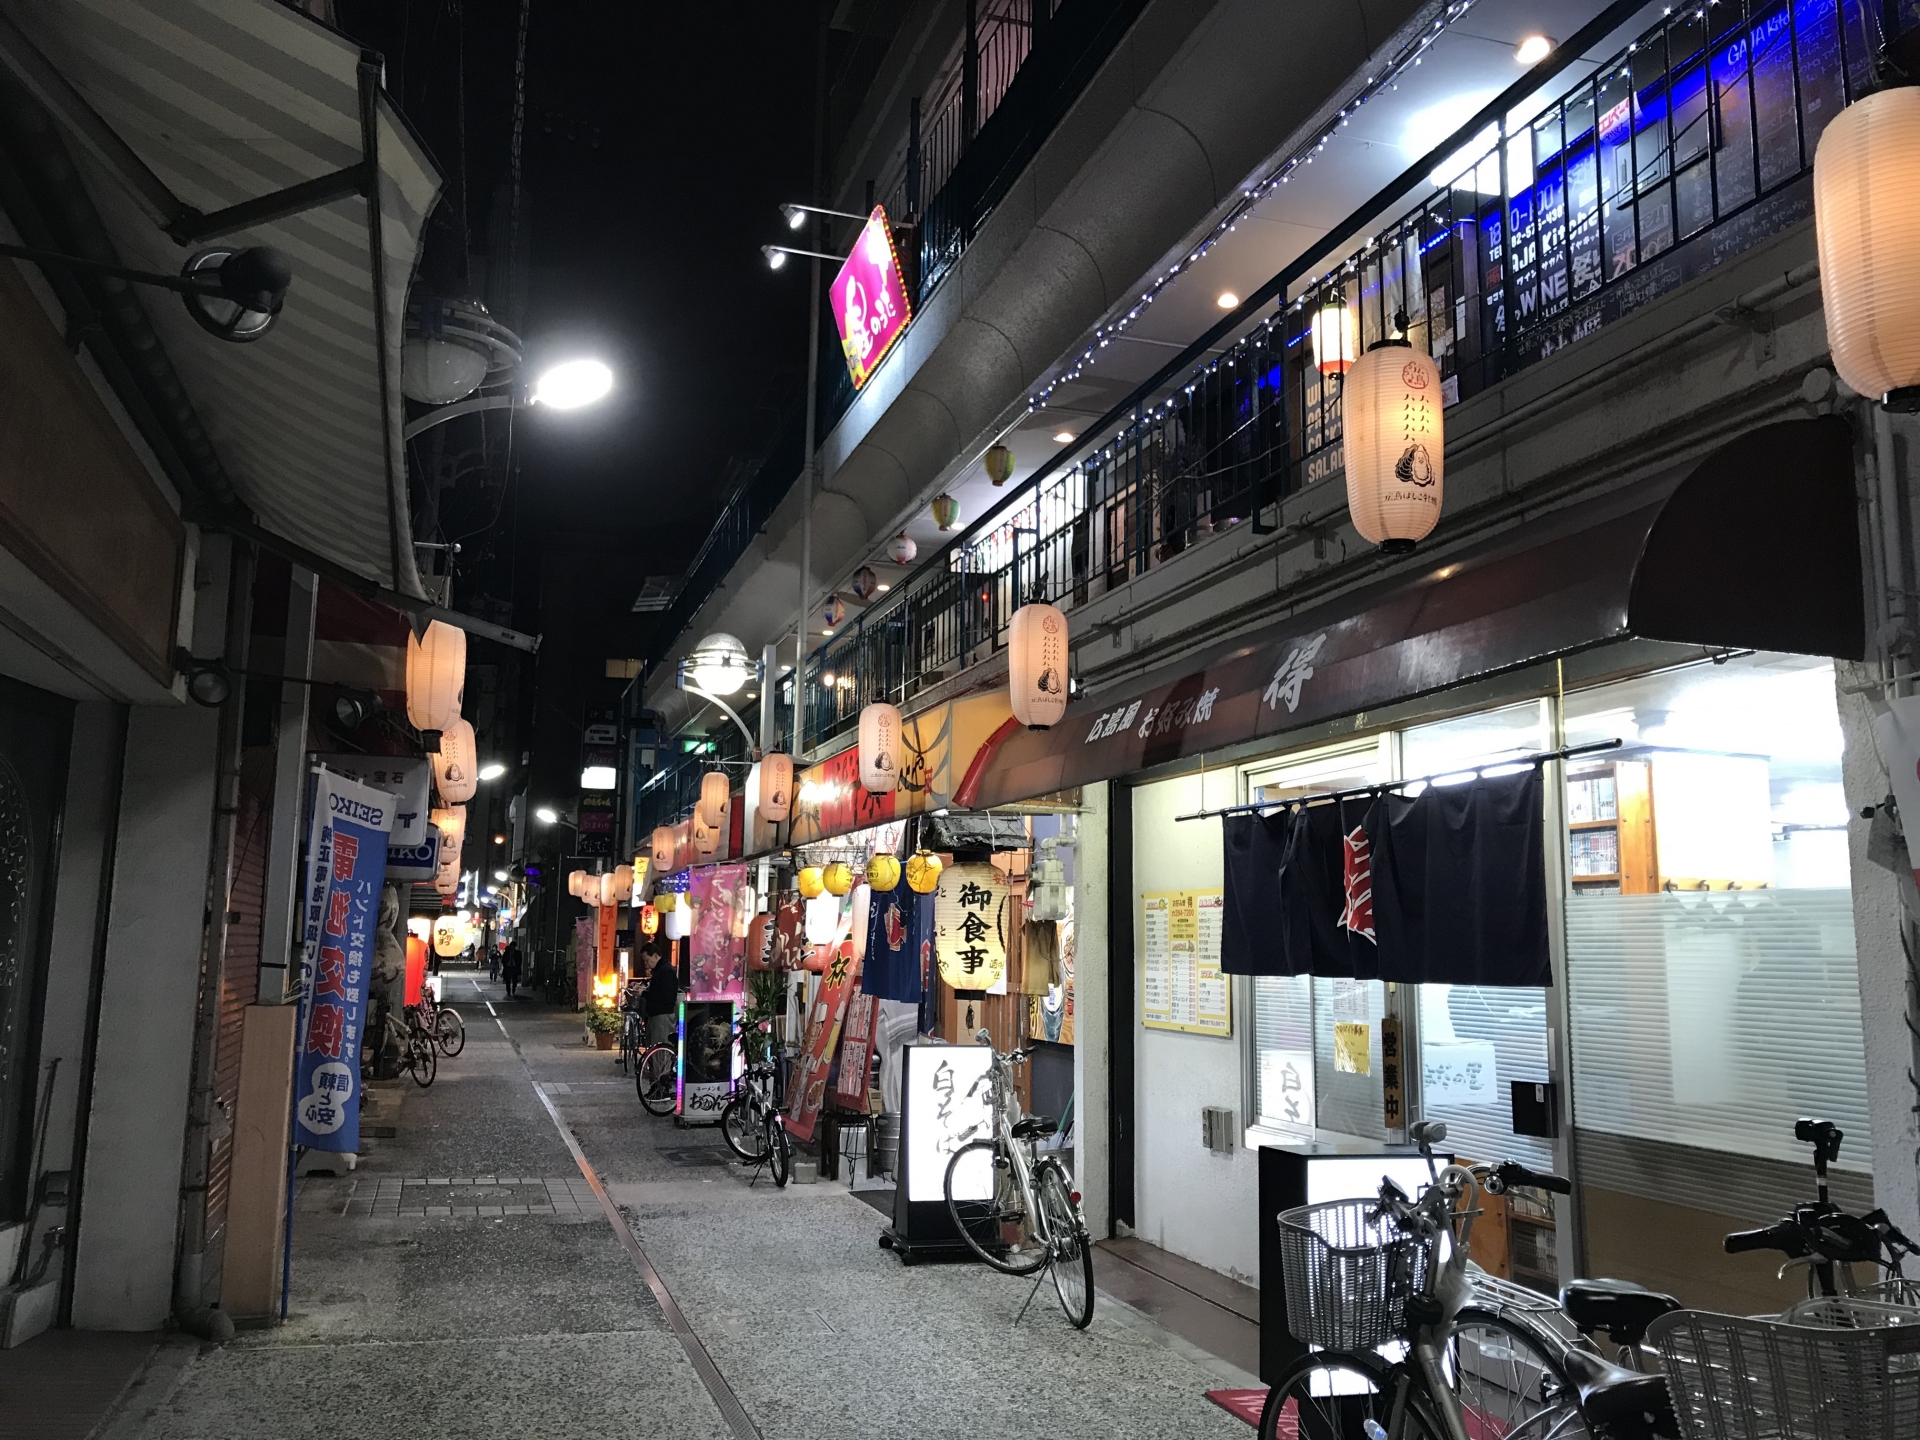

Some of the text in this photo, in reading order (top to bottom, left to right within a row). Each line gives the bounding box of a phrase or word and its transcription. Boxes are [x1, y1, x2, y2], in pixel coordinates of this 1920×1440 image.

[1084, 633, 1327, 744] 広島風 お好み焼 得
[955, 881, 993, 975] 御食事
[1383, 1031, 1400, 1120] 営業中
